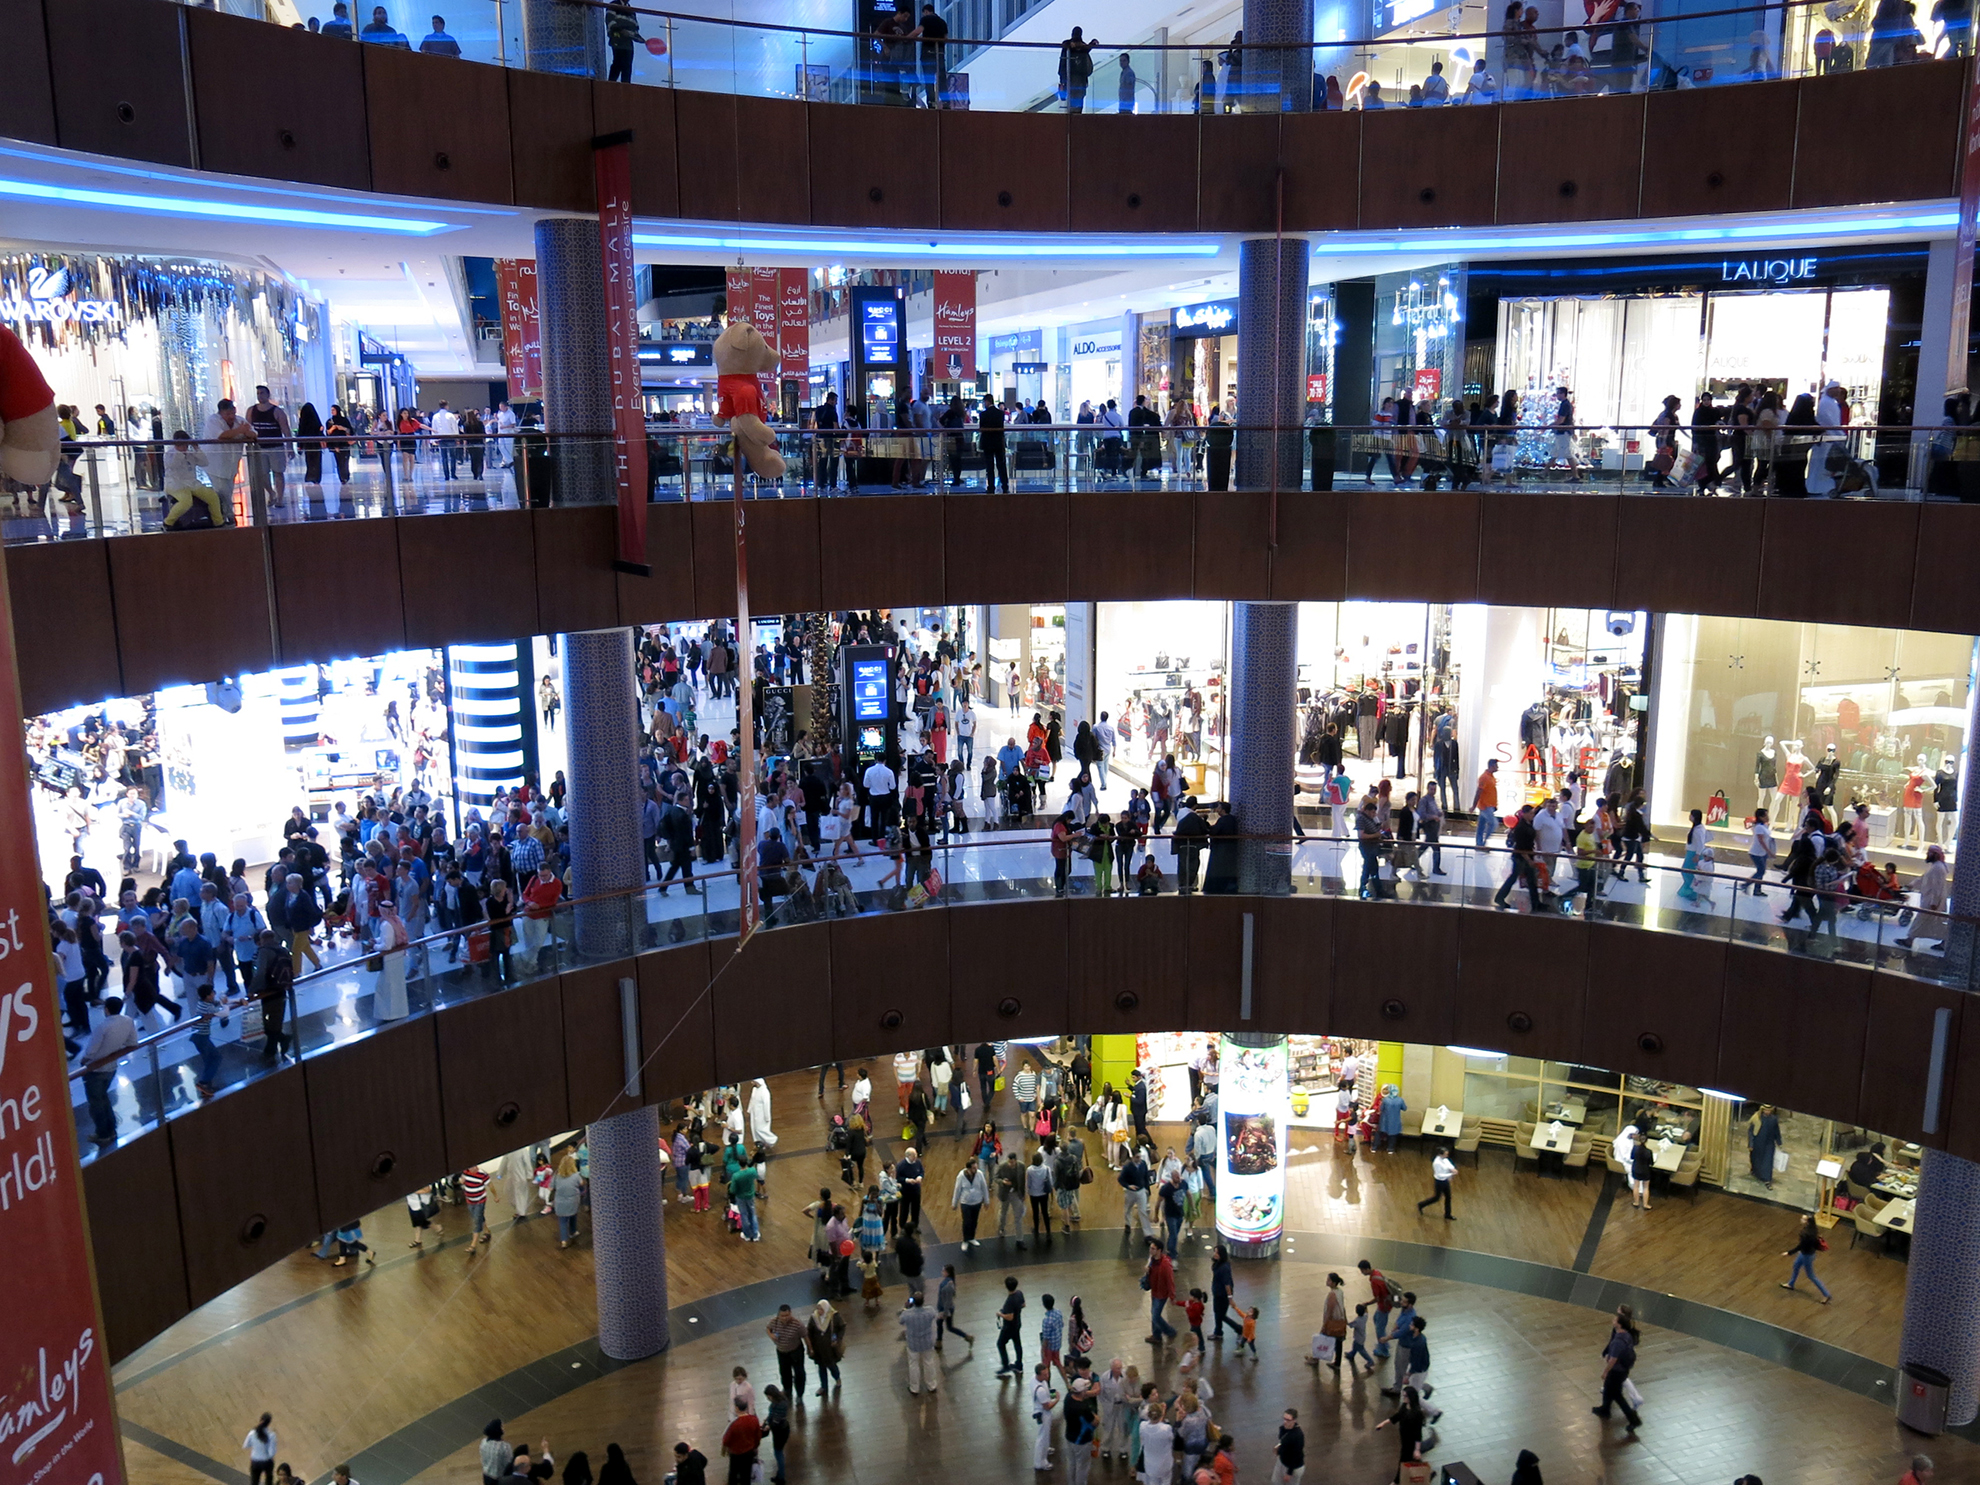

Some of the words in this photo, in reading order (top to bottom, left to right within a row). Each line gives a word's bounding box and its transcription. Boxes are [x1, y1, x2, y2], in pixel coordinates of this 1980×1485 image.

[606, 196, 620, 283] MALL
[620, 200, 634, 259] desire
[624, 265, 636, 301] you
[1722, 258, 1818, 284] LALIQUE
[754, 302, 774, 310] Finest
[758, 294, 771, 302] The
[754, 310, 775, 320] Toys
[936, 300, 975, 323] Hamleys
[938, 336, 961, 345] LEVEL
[965, 336, 971, 345] 2
[1073, 341, 1096, 355] ALDO
[611, 304, 624, 410] DUBAI
[626, 307, 642, 410] Everything
[1496, 742, 1600, 770] SALE
[0, 1328, 94, 1444] amleys
[60, 1440, 74, 1457] the
